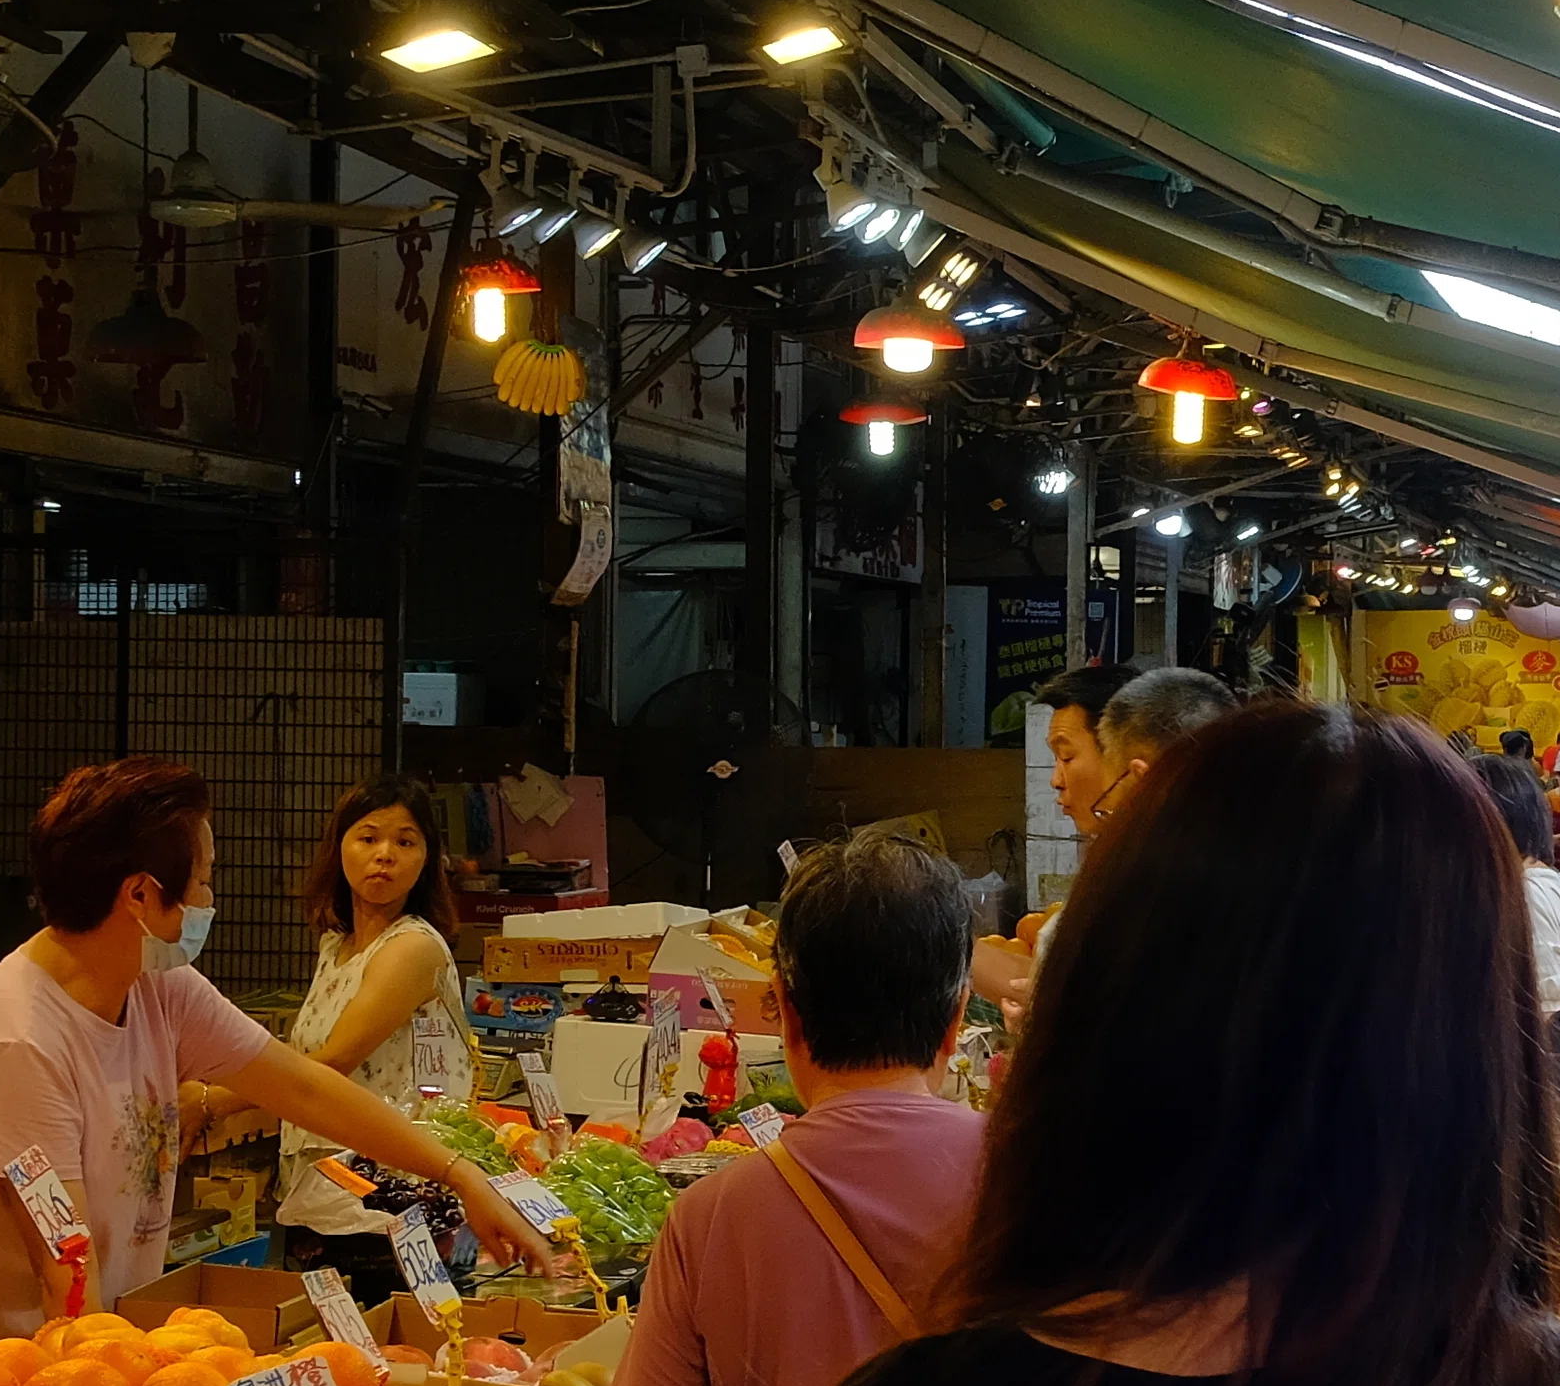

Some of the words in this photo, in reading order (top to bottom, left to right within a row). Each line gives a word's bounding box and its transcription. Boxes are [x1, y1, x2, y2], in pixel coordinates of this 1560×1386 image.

[1027, 599, 1060, 610] Tropical
[1391, 655, 1414, 668] KS
[497, 904, 535, 915] Crunch
